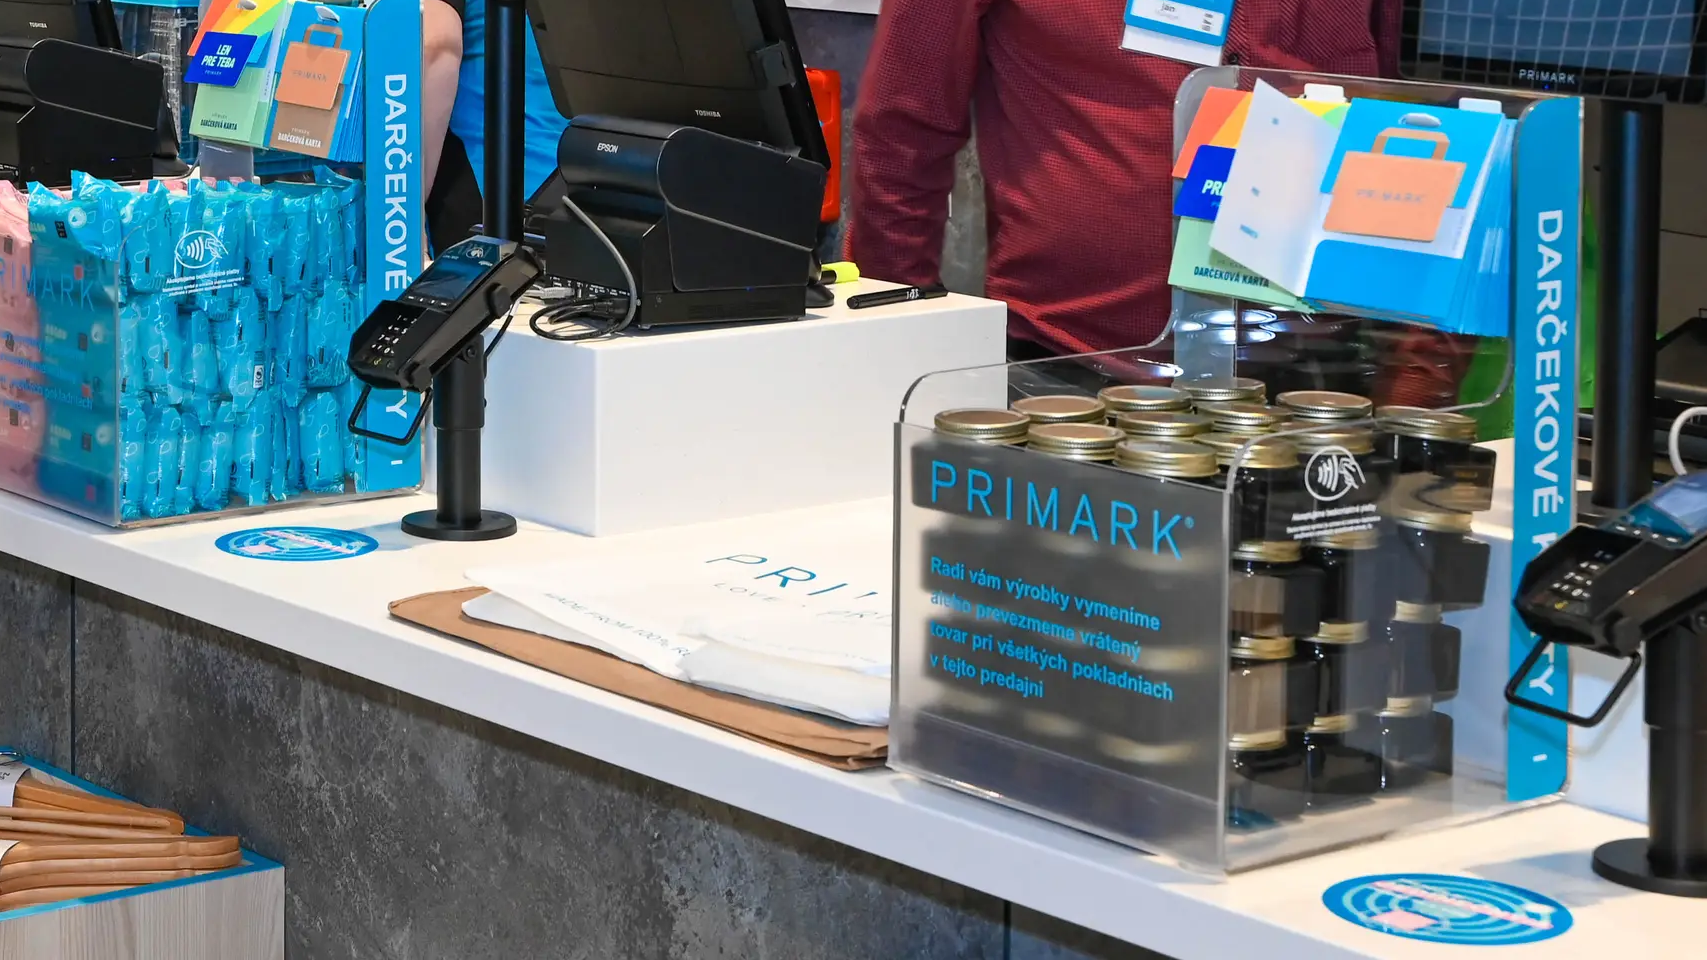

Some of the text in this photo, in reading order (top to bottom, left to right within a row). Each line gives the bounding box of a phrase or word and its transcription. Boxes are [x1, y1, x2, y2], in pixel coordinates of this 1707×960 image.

[201, 55, 236, 69] PRE TEBA
[216, 44, 233, 56] LEN
[1518, 68, 1576, 84] PRIMARK
[694, 109, 722, 118] TOSHIBA
[597, 142, 619, 153] EPSON
[384, 74, 413, 292] DARČEKOVÉ
[1241, 274, 1269, 288] KARTA
[1532, 210, 1568, 517] DARČEKOVÉ
[705, 554, 879, 599] PRI
[931, 556, 965, 581] Radi
[969, 568, 1001, 590] vám
[1006, 577, 1070, 612] výrobky
[975, 603, 1076, 642] prevezmeme
[1079, 624, 1142, 663] vrátený
[930, 620, 1174, 702] tovar pri všetkých pokladniach
[930, 654, 1044, 699] v tejto predajni
